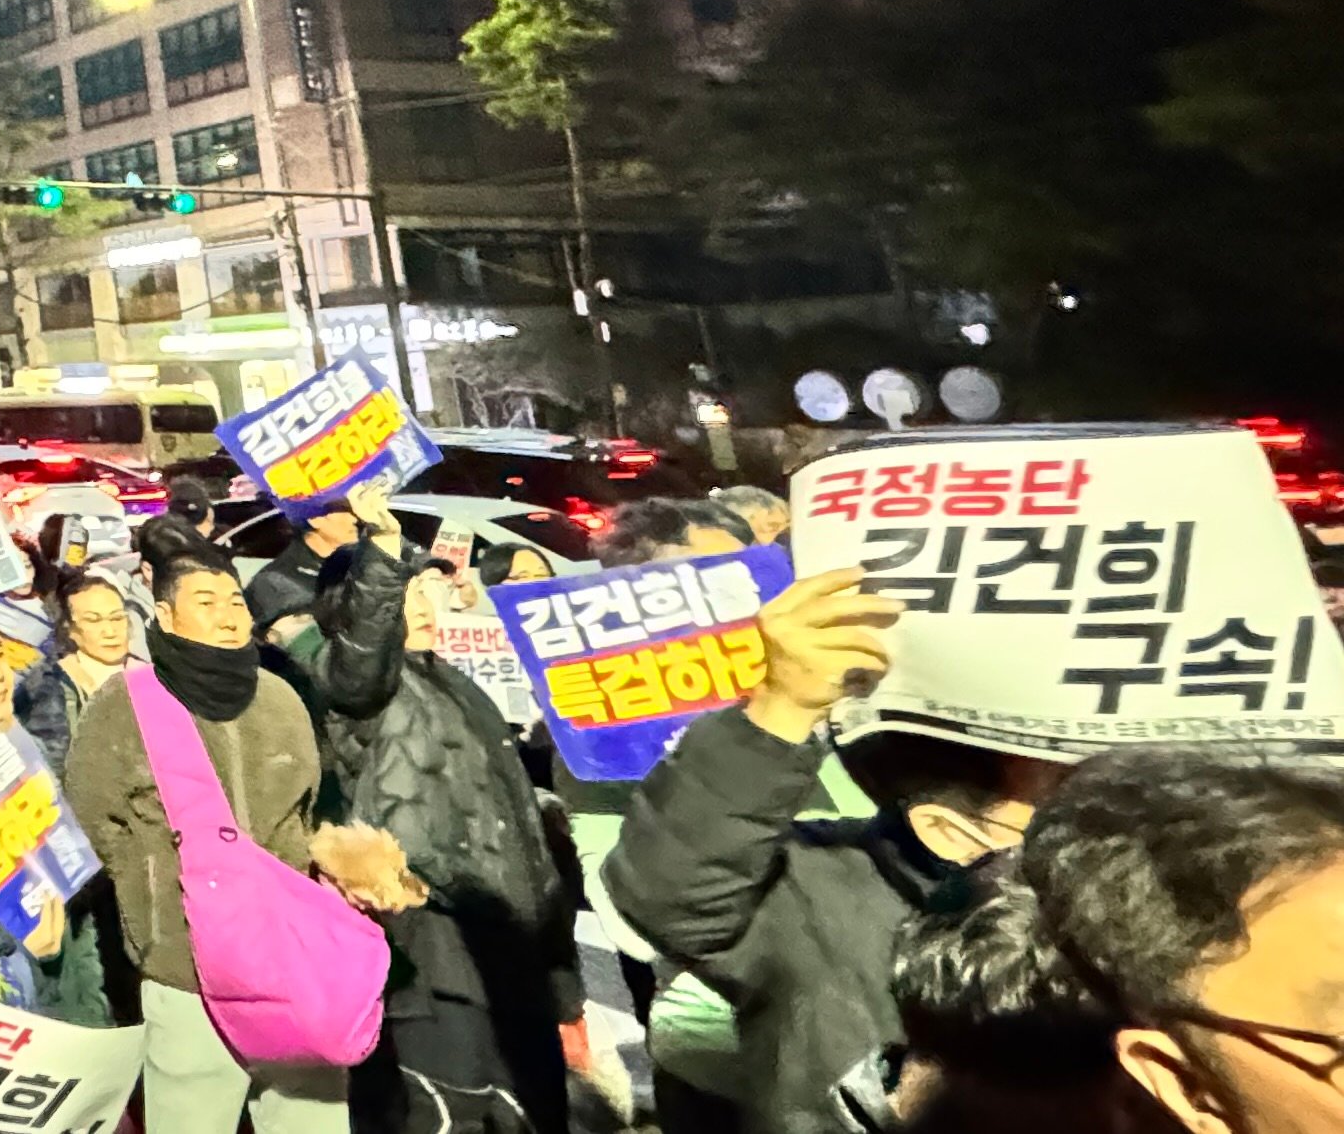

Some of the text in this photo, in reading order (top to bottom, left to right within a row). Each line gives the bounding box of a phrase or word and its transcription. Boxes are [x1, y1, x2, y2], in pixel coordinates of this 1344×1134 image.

[807, 458, 1091, 522] 국정농단
[858, 520, 1197, 614] 김건희
[1057, 615, 1314, 715] 구속!
